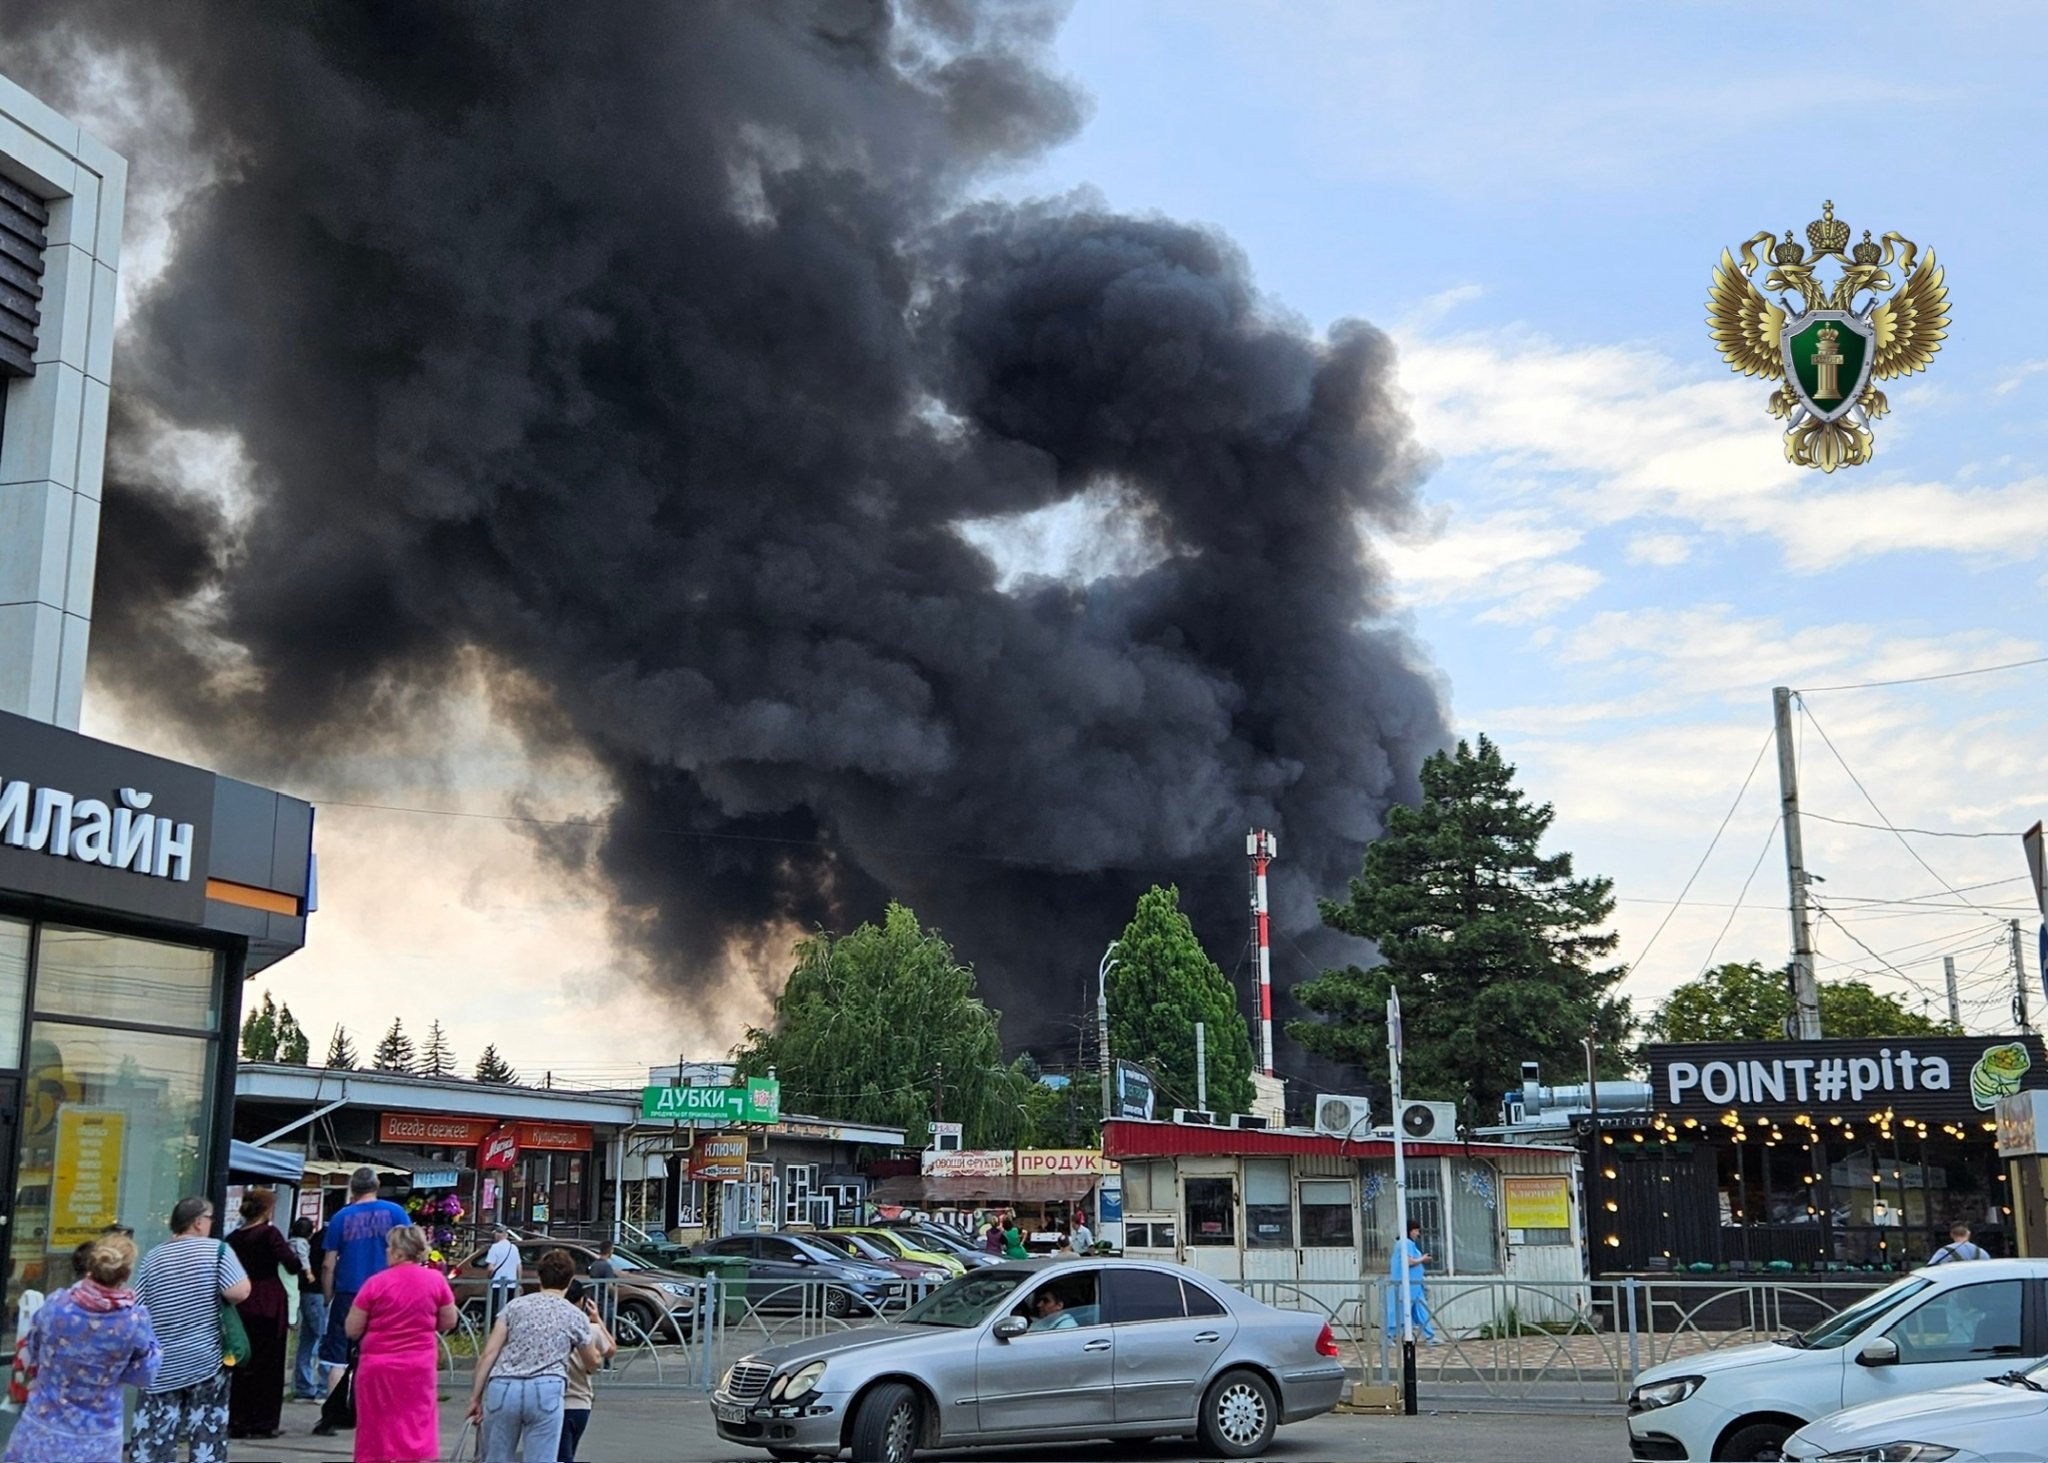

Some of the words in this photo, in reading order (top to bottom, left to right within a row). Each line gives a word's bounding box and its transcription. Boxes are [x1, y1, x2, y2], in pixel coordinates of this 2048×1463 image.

[1668, 1049, 1950, 1104] POINT#pita
[657, 1088, 725, 1110] ДУБКИ
[388, 1117, 424, 1136] Всегда
[427, 1122, 469, 1139] свежее!
[532, 1127, 577, 1145] Кулинария
[704, 1142, 743, 1157] КЛЮЧИ
[966, 1156, 1003, 1169] ФРУКТЫ
